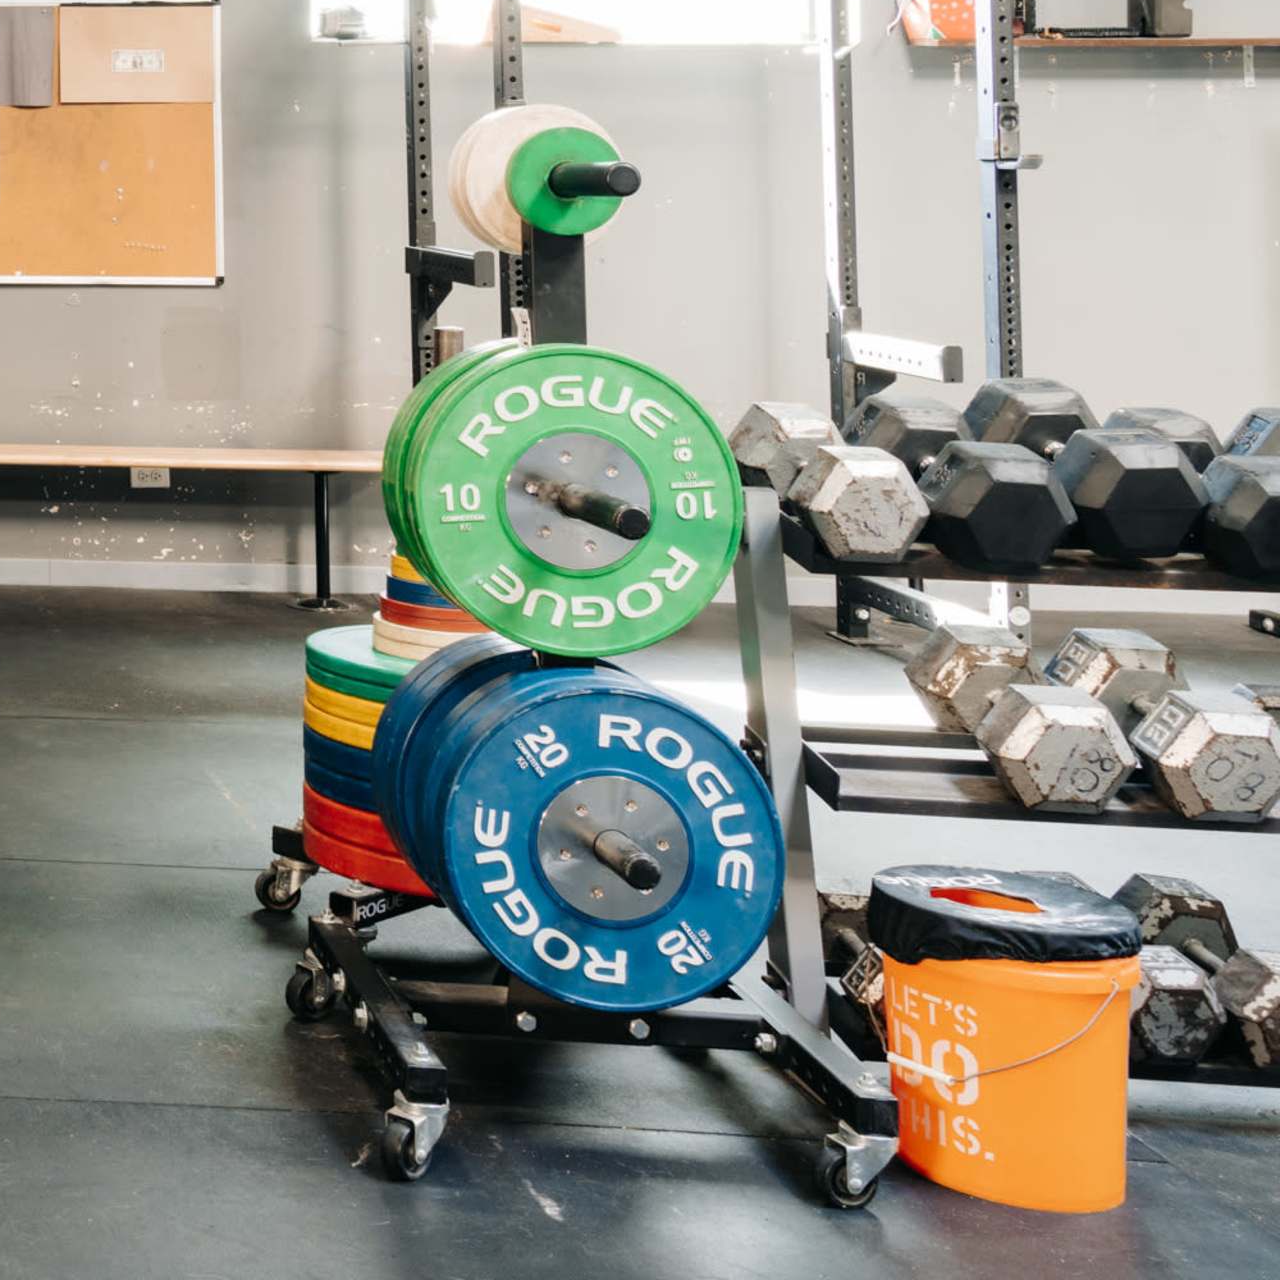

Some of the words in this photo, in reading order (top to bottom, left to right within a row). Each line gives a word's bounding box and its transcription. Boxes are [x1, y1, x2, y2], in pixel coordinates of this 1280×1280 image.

[458, 375, 675, 458] ROGUE
[439, 483, 481, 512] 10
[675, 491, 717, 520] 10
[481, 546, 700, 629] ROGUE
[523, 724, 569, 769] 20
[597, 713, 756, 893] ROGUE
[473, 806, 628, 985] ROGUE
[656, 929, 705, 975] 20
[889, 974, 979, 1038] LET'S
[893, 1018, 980, 1108] DO
